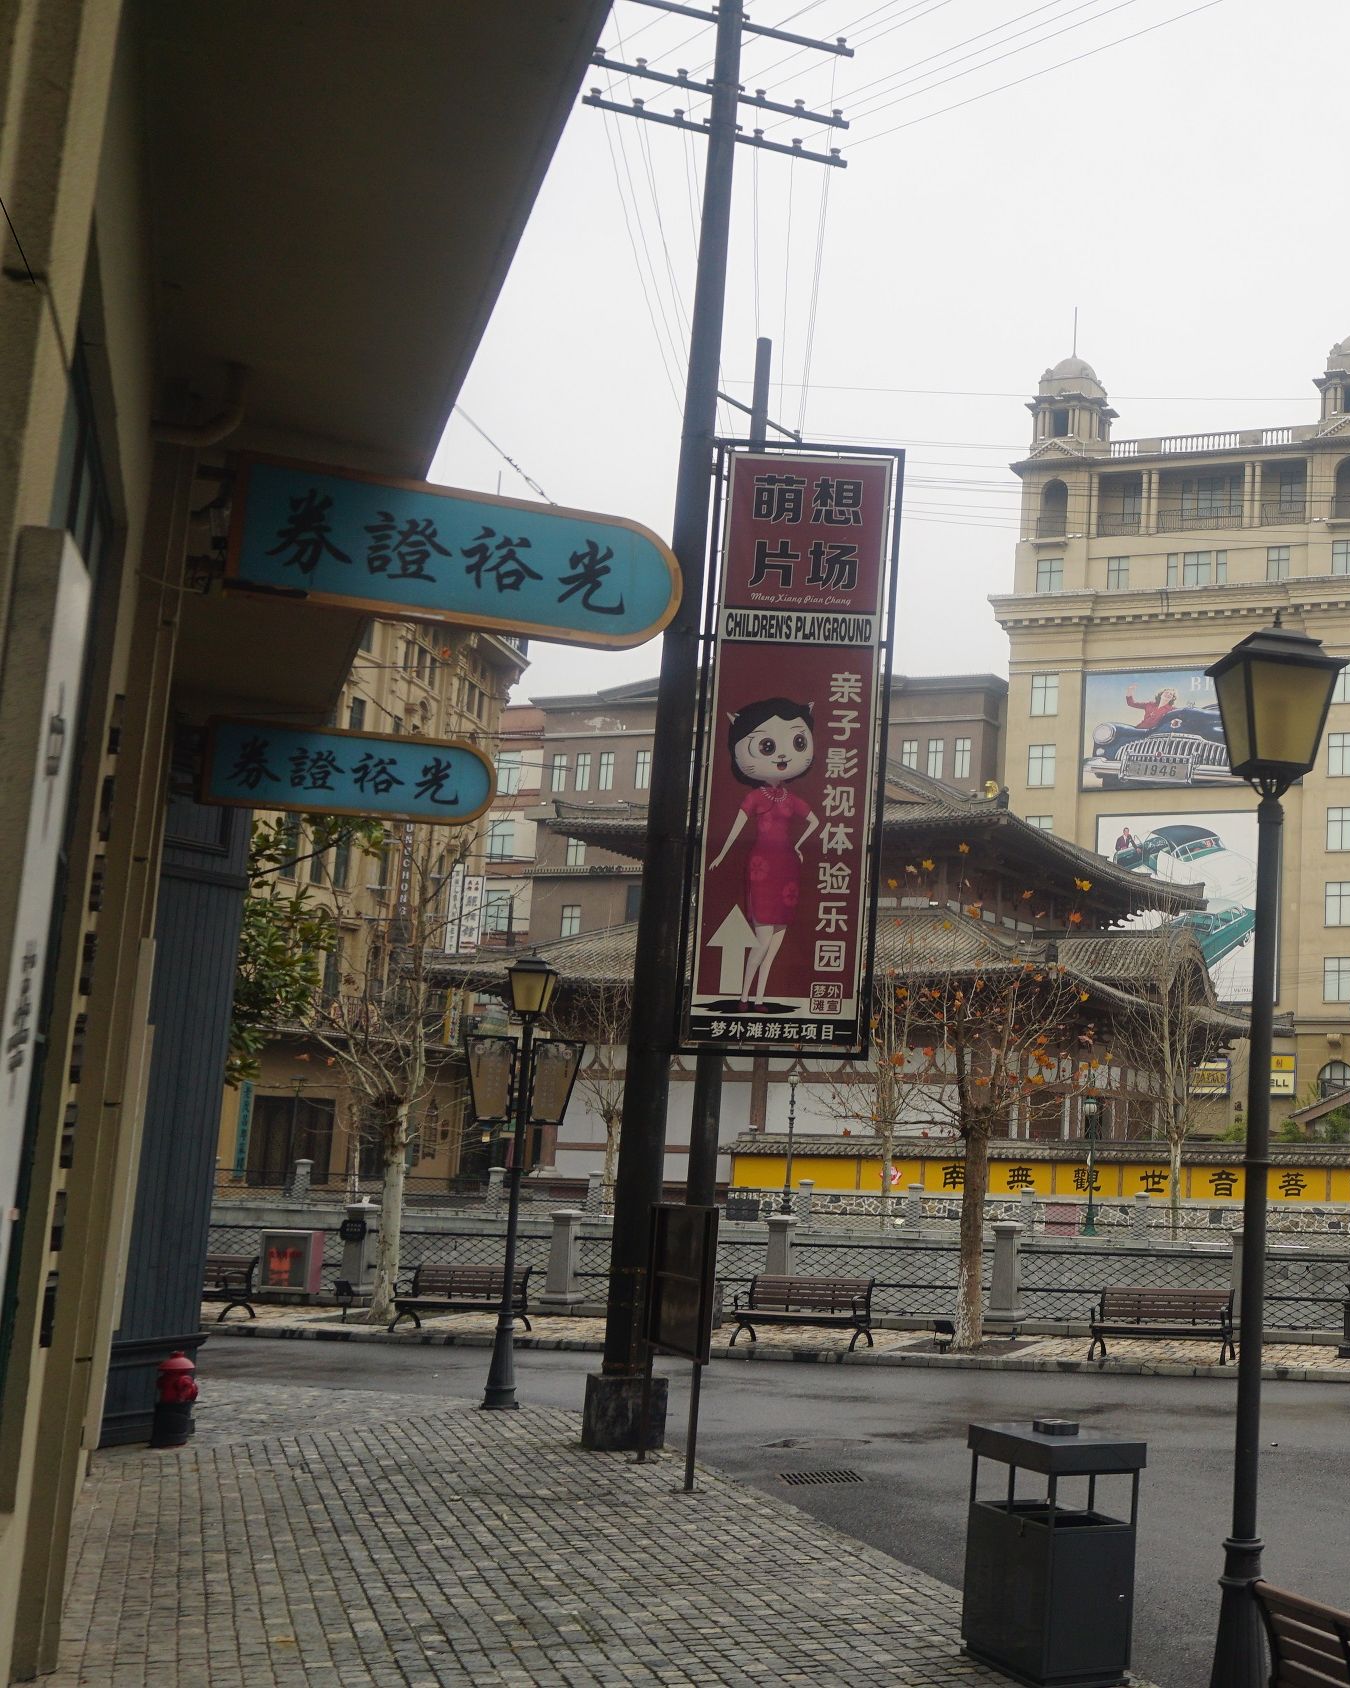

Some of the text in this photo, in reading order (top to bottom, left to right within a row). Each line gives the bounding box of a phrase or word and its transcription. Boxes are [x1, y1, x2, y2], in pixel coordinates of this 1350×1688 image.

[753, 474, 863, 526] 萌想
[748, 540, 859, 591] 片场
[726, 612, 872, 643] CHILDREN'S PLAYGROUND
[814, 672, 863, 972] 亲子影视体验乐园
[813, 984, 841, 998] 梦外
[710, 1021, 834, 1041] 梦外滩游玩项目
